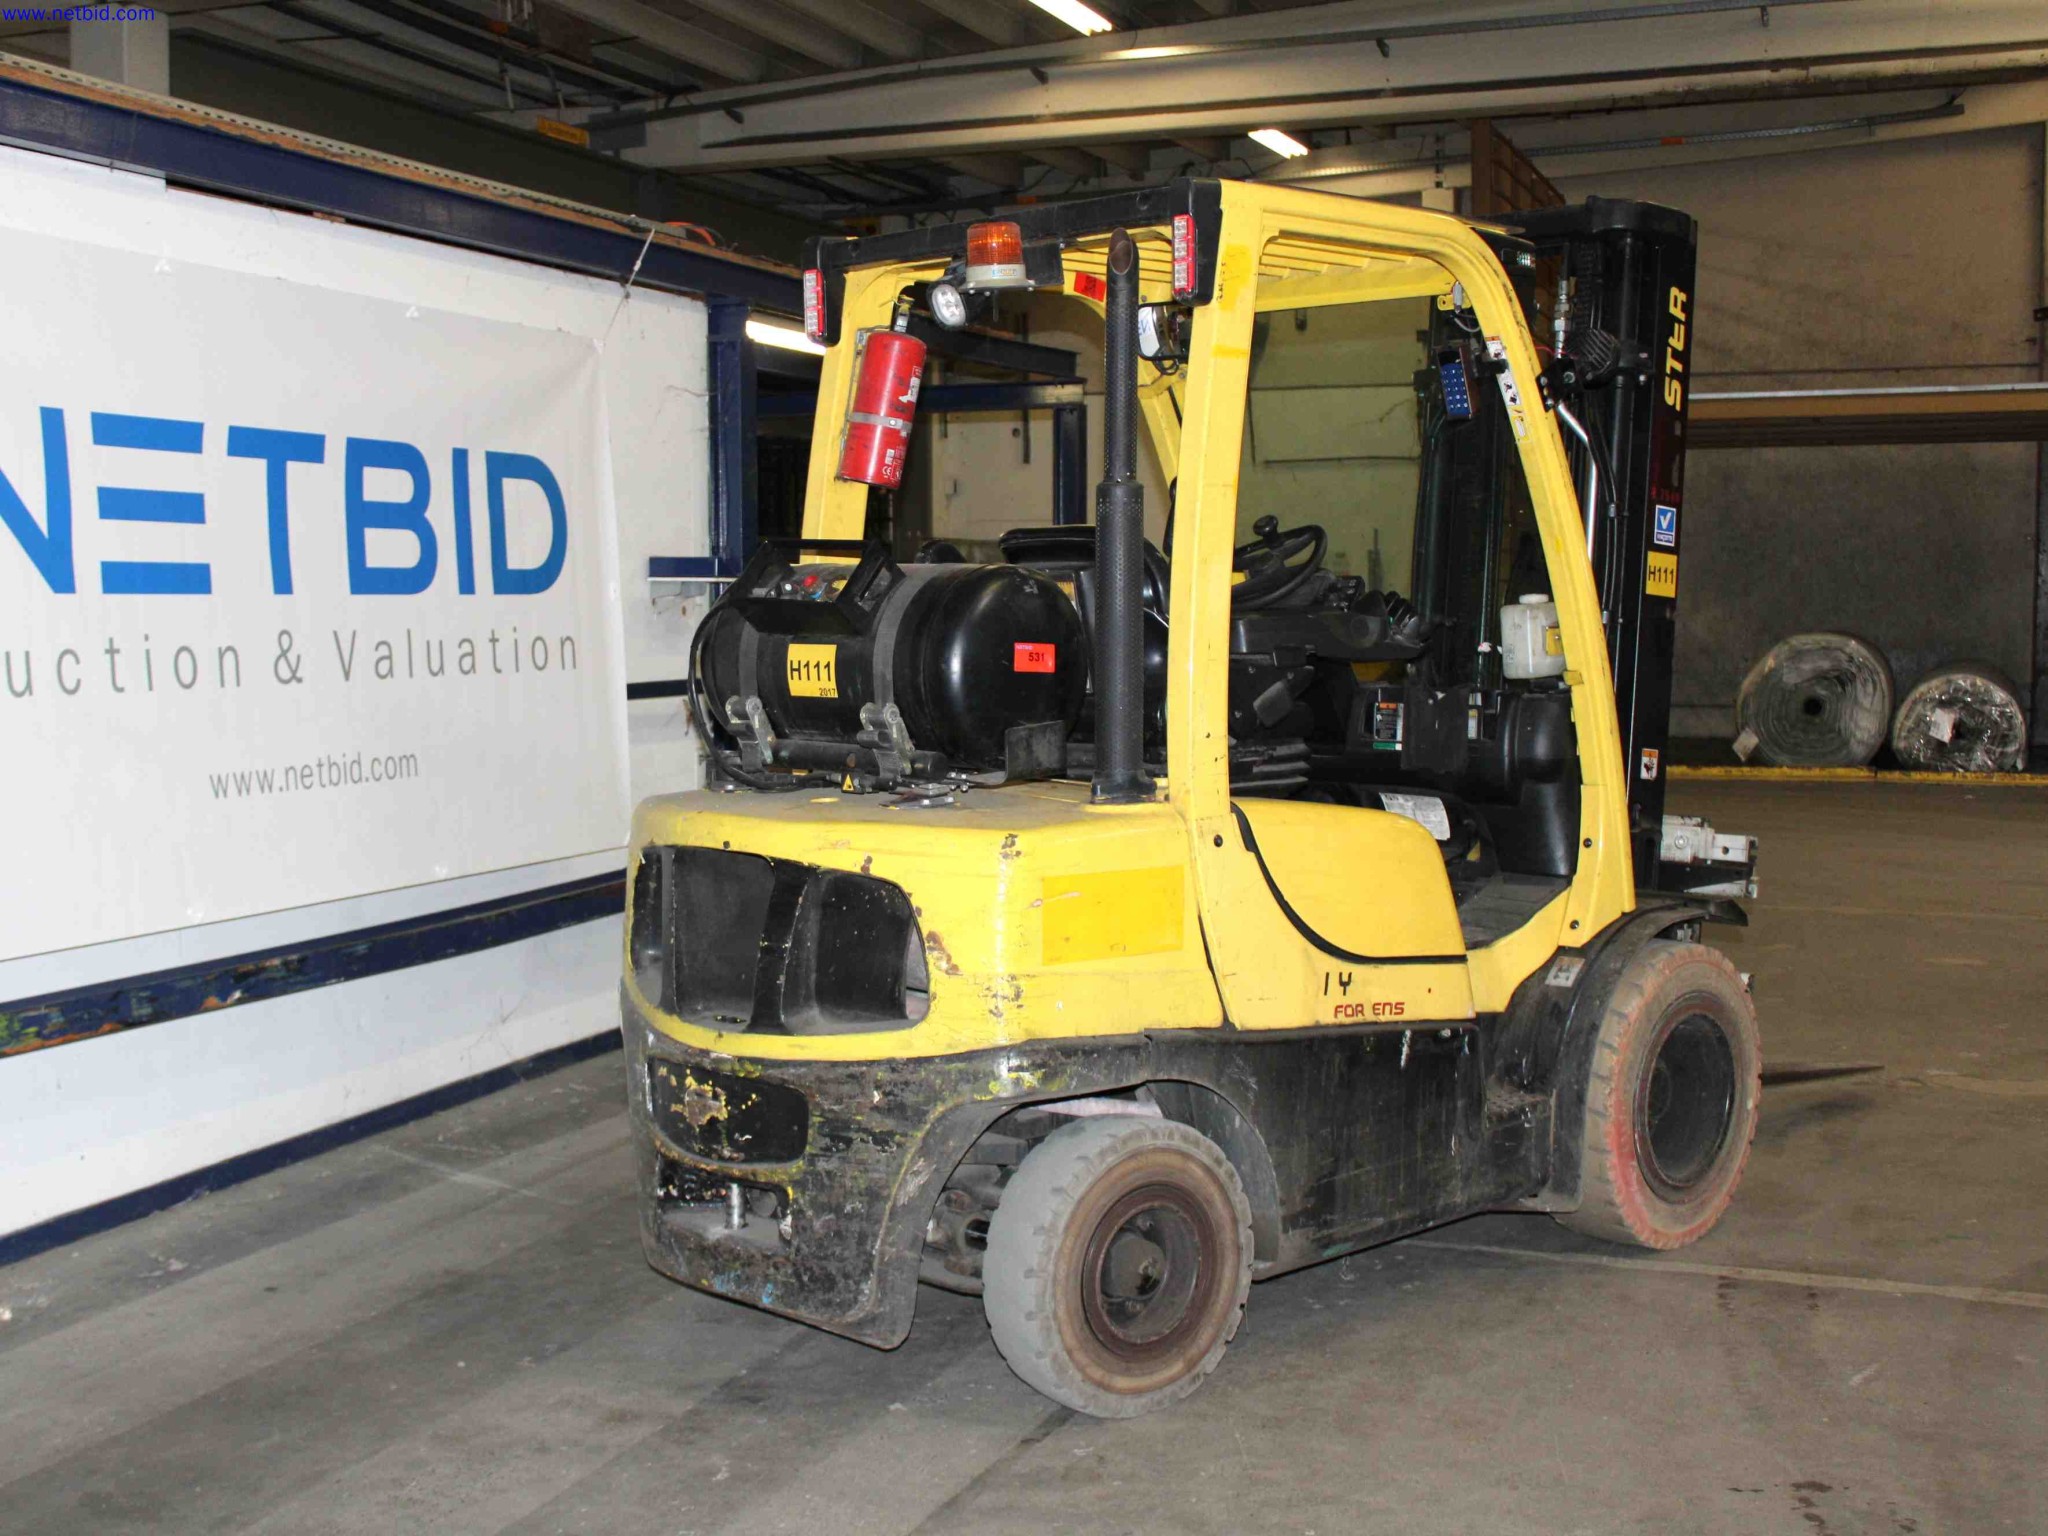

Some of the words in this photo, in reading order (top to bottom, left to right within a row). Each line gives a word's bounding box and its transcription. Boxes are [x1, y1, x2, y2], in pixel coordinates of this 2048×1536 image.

[0, 406, 567, 595] NETBID
[1648, 565, 1674, 585] H111
[273, 629, 303, 684] &
[333, 626, 578, 682] Valuation
[1028, 651, 1045, 662] 531
[789, 659, 831, 682] H111
[209, 750, 419, 799] www.netbid.com
[1333, 1003, 1365, 1018] FOR
[1372, 1001, 1405, 1016] ENS
